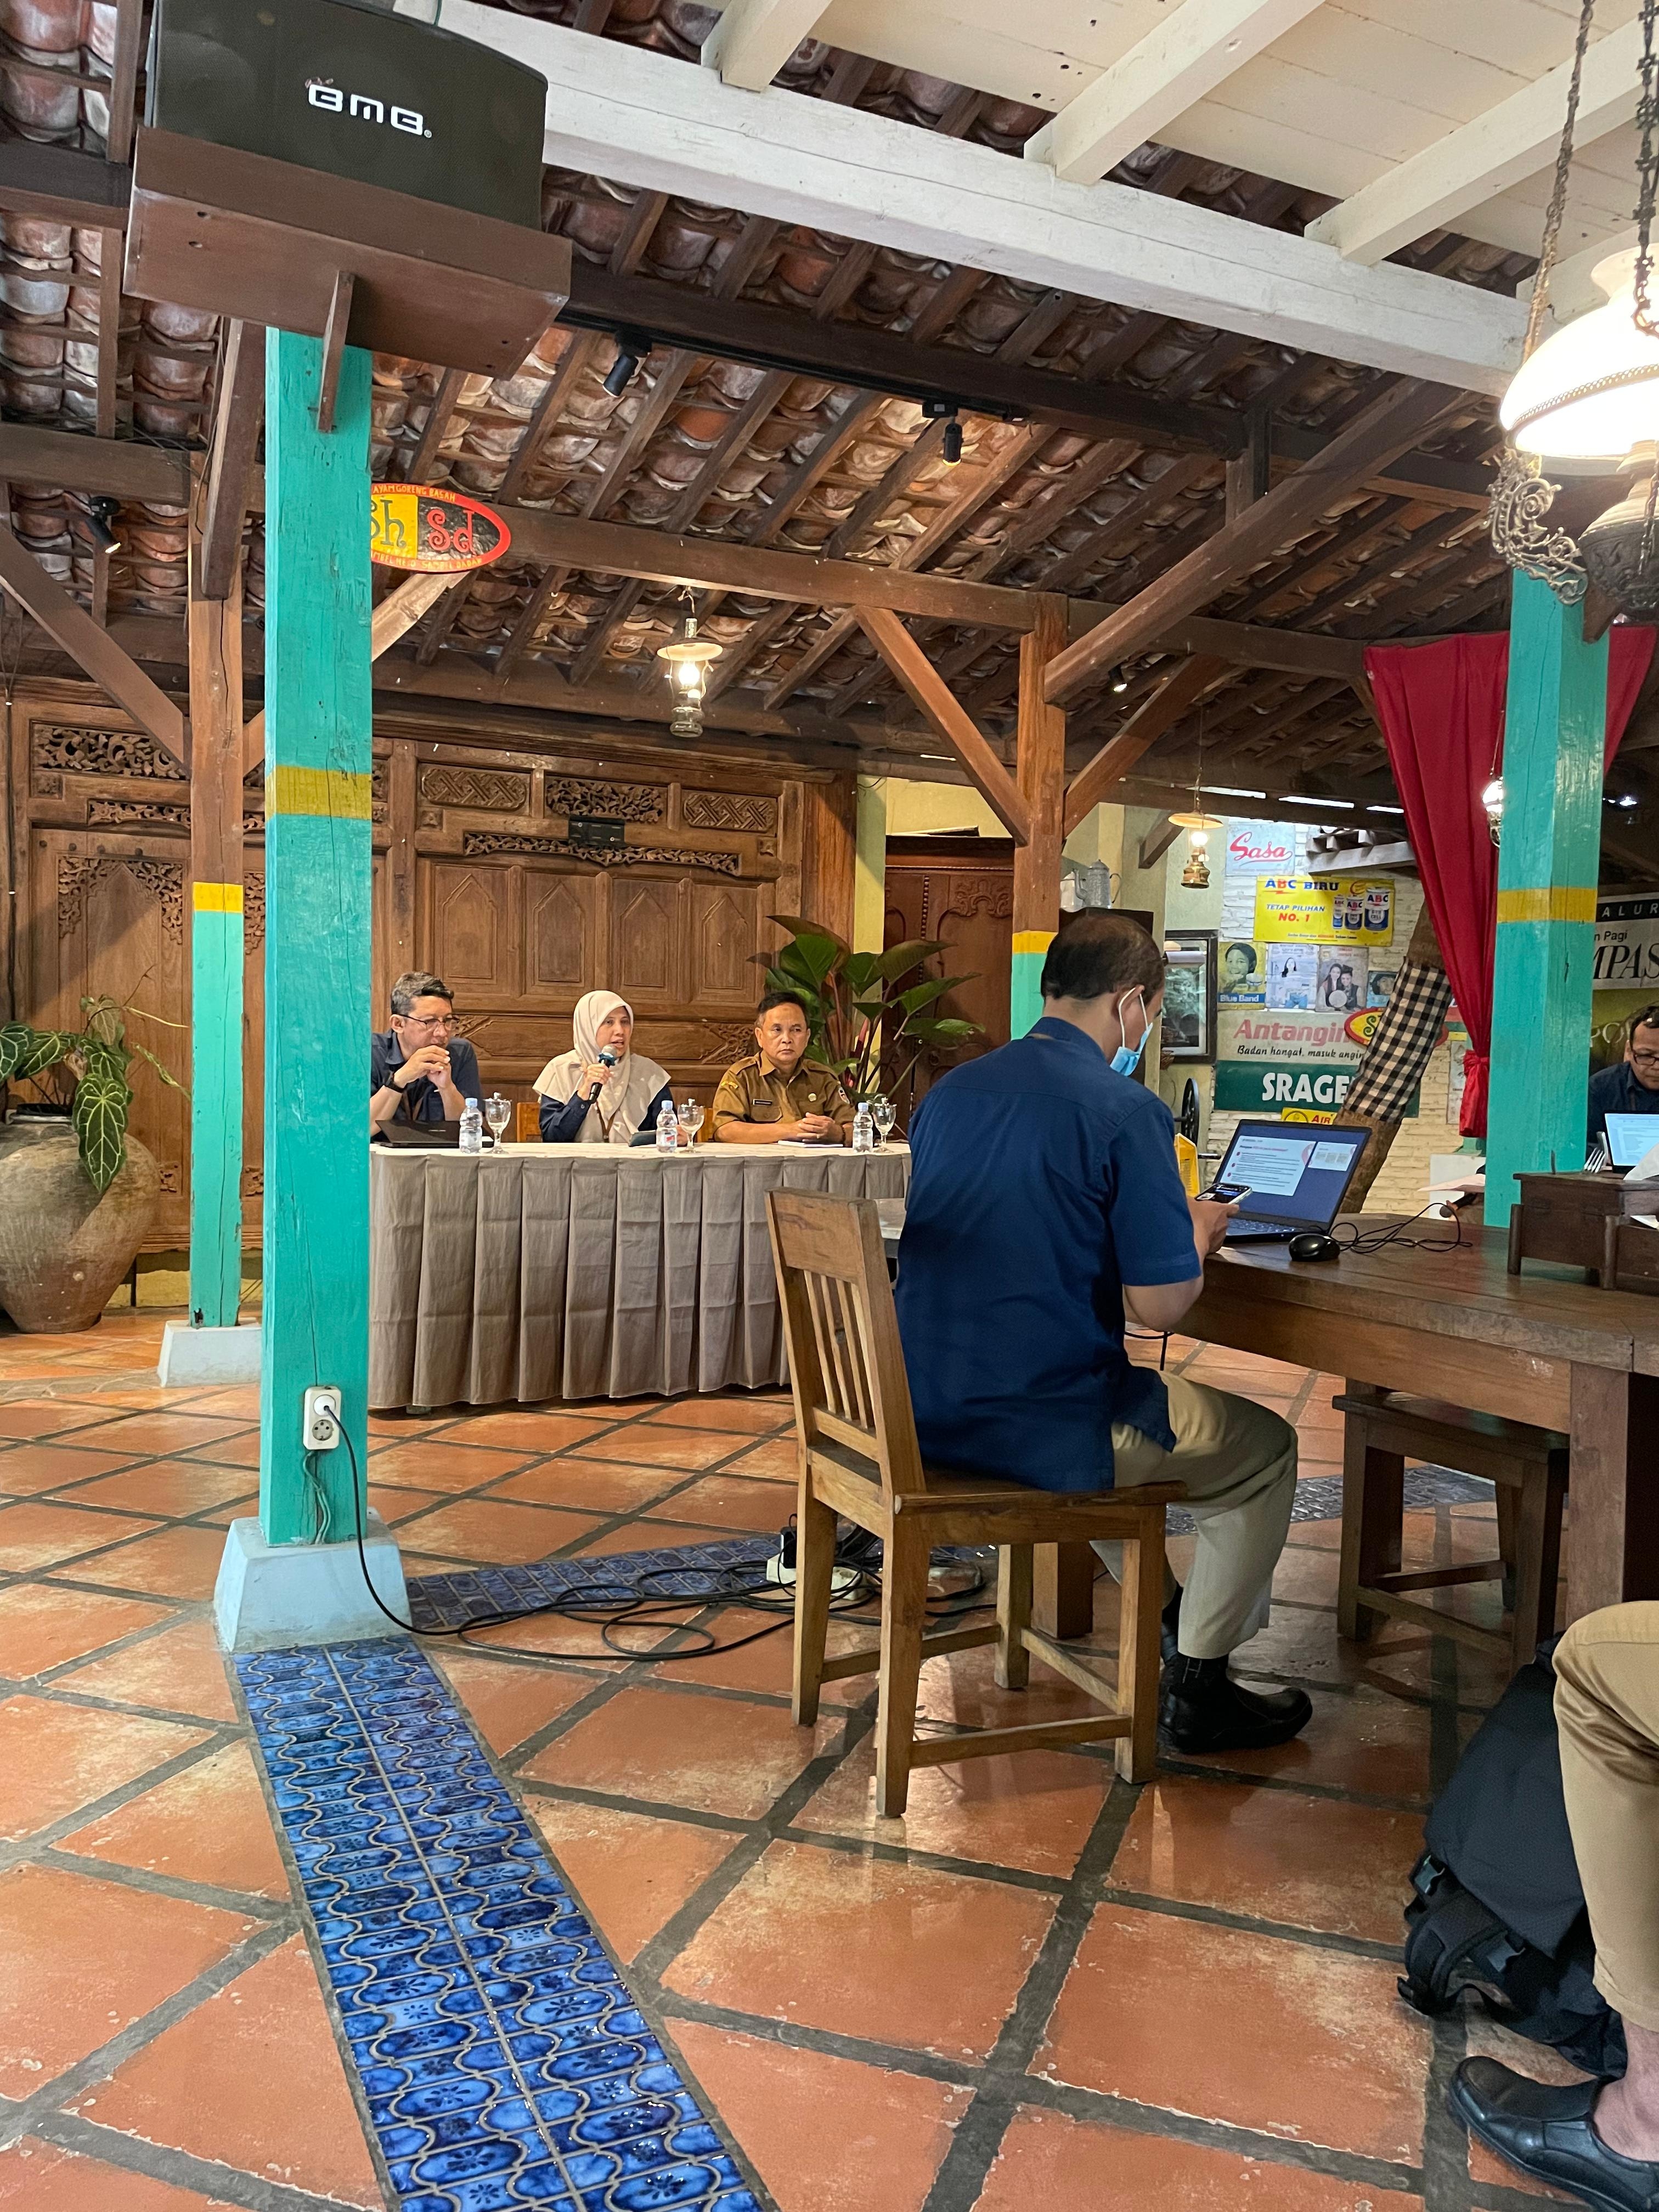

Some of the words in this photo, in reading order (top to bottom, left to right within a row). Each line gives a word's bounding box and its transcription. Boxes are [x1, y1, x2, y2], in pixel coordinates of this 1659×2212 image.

[373, 485, 395, 494] AYAM
[396, 486, 427, 495] GORENG
[429, 488, 455, 503] BASAH
[1230, 831, 1293, 866] Sasa
[1265, 878, 1297, 889] ABC
[1304, 881, 1339, 891] BIRU
[1368, 894, 1389, 902] ABC
[1278, 912, 1299, 922] NO.
[1305, 914, 1310, 922] 1
[1604, 929, 1628, 943] Pagi
[1239, 994, 1259, 1002] Band
[1238, 1045, 1267, 1054] Badan
[1307, 1048, 1336, 1058] masuk
[1262, 1072, 1355, 1104] SRAGE
[1312, 1115, 1331, 1124] AIR
